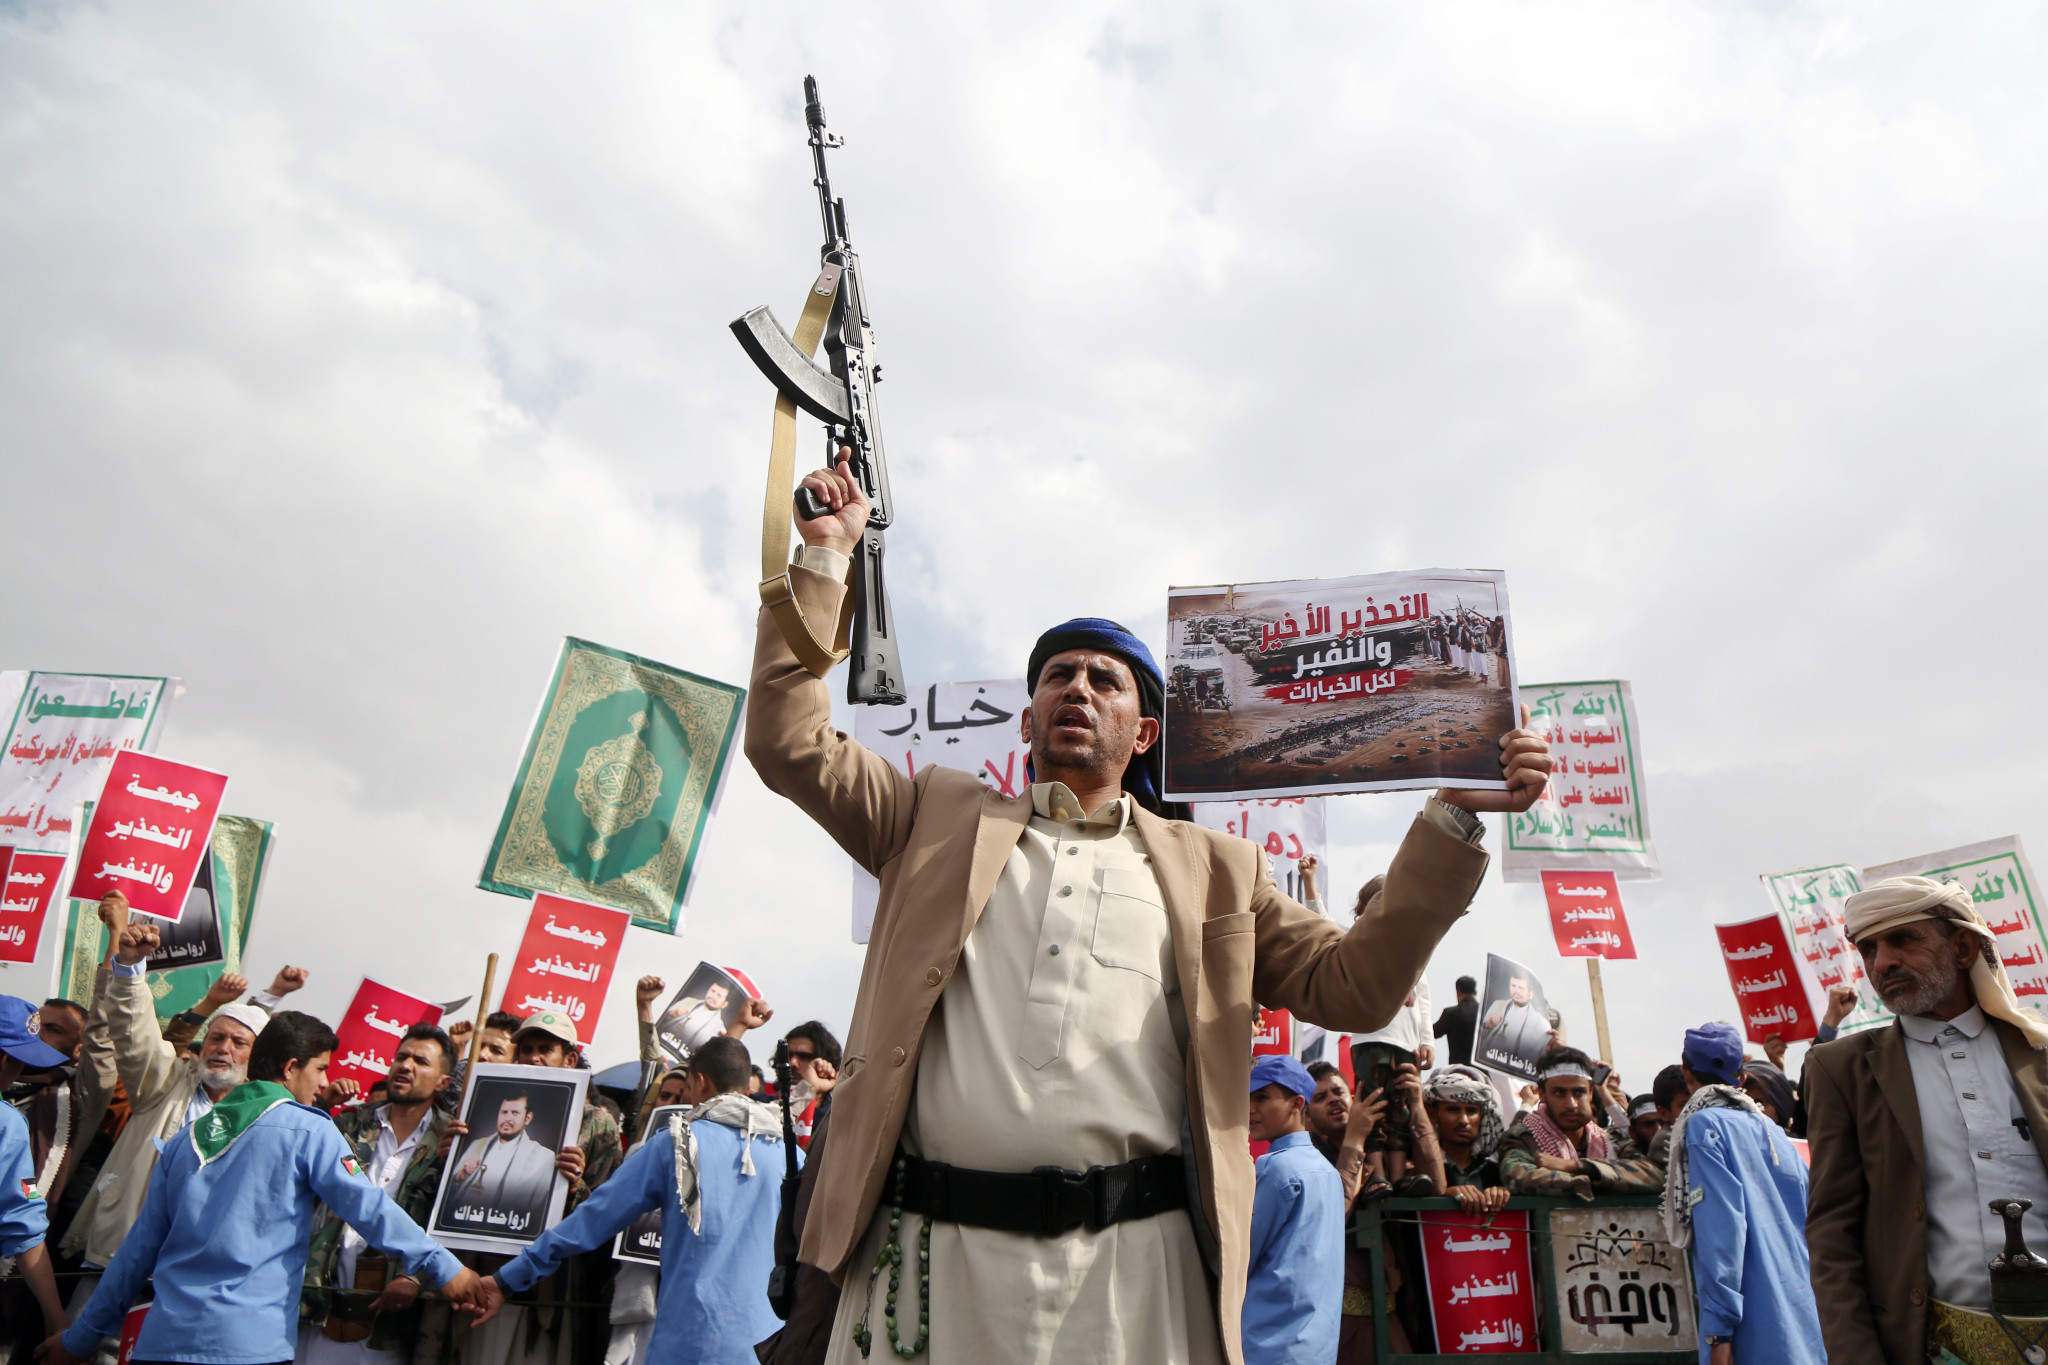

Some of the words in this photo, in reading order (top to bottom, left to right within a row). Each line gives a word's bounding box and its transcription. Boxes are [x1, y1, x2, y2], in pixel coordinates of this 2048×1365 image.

[1258, 602, 1331, 653] الأخير
[1337, 593, 1430, 641] التحذير
[1289, 675, 1362, 702] الخيارات
[1364, 671, 1396, 694] لكل
[26, 686, 152, 724] قاطعوا
[1570, 726, 1622, 748] الموت
[1573, 755, 1626, 779] الموت
[126, 773, 201, 813] جمعة
[105, 816, 192, 851] التحذير
[1582, 812, 1634, 844] النصر
[8, 872, 46, 888] جمع
[93, 856, 174, 894] والنفير
[1557, 882, 1608, 899] جمعة
[1, 897, 39, 912] التح
[1562, 905, 1616, 923] التحذير
[0, 925, 26, 946] والن
[544, 914, 608, 950] جمعة
[1987, 908, 2031, 936] المو
[1569, 930, 1622, 948] والنفير
[526, 954, 601, 983] التحذير
[517, 990, 586, 1022] والنفير
[363, 1004, 410, 1039] معة
[1509, 1053, 1538, 1076] رواحنا
[453, 1204, 485, 1223] فداك
[486, 1207, 531, 1231] ارواحنا
[638, 1231, 662, 1249] داك
[1443, 1229, 1512, 1255] جمعة
[1447, 1270, 1519, 1305] التحذير
[1456, 1317, 1524, 1351] والنفير
